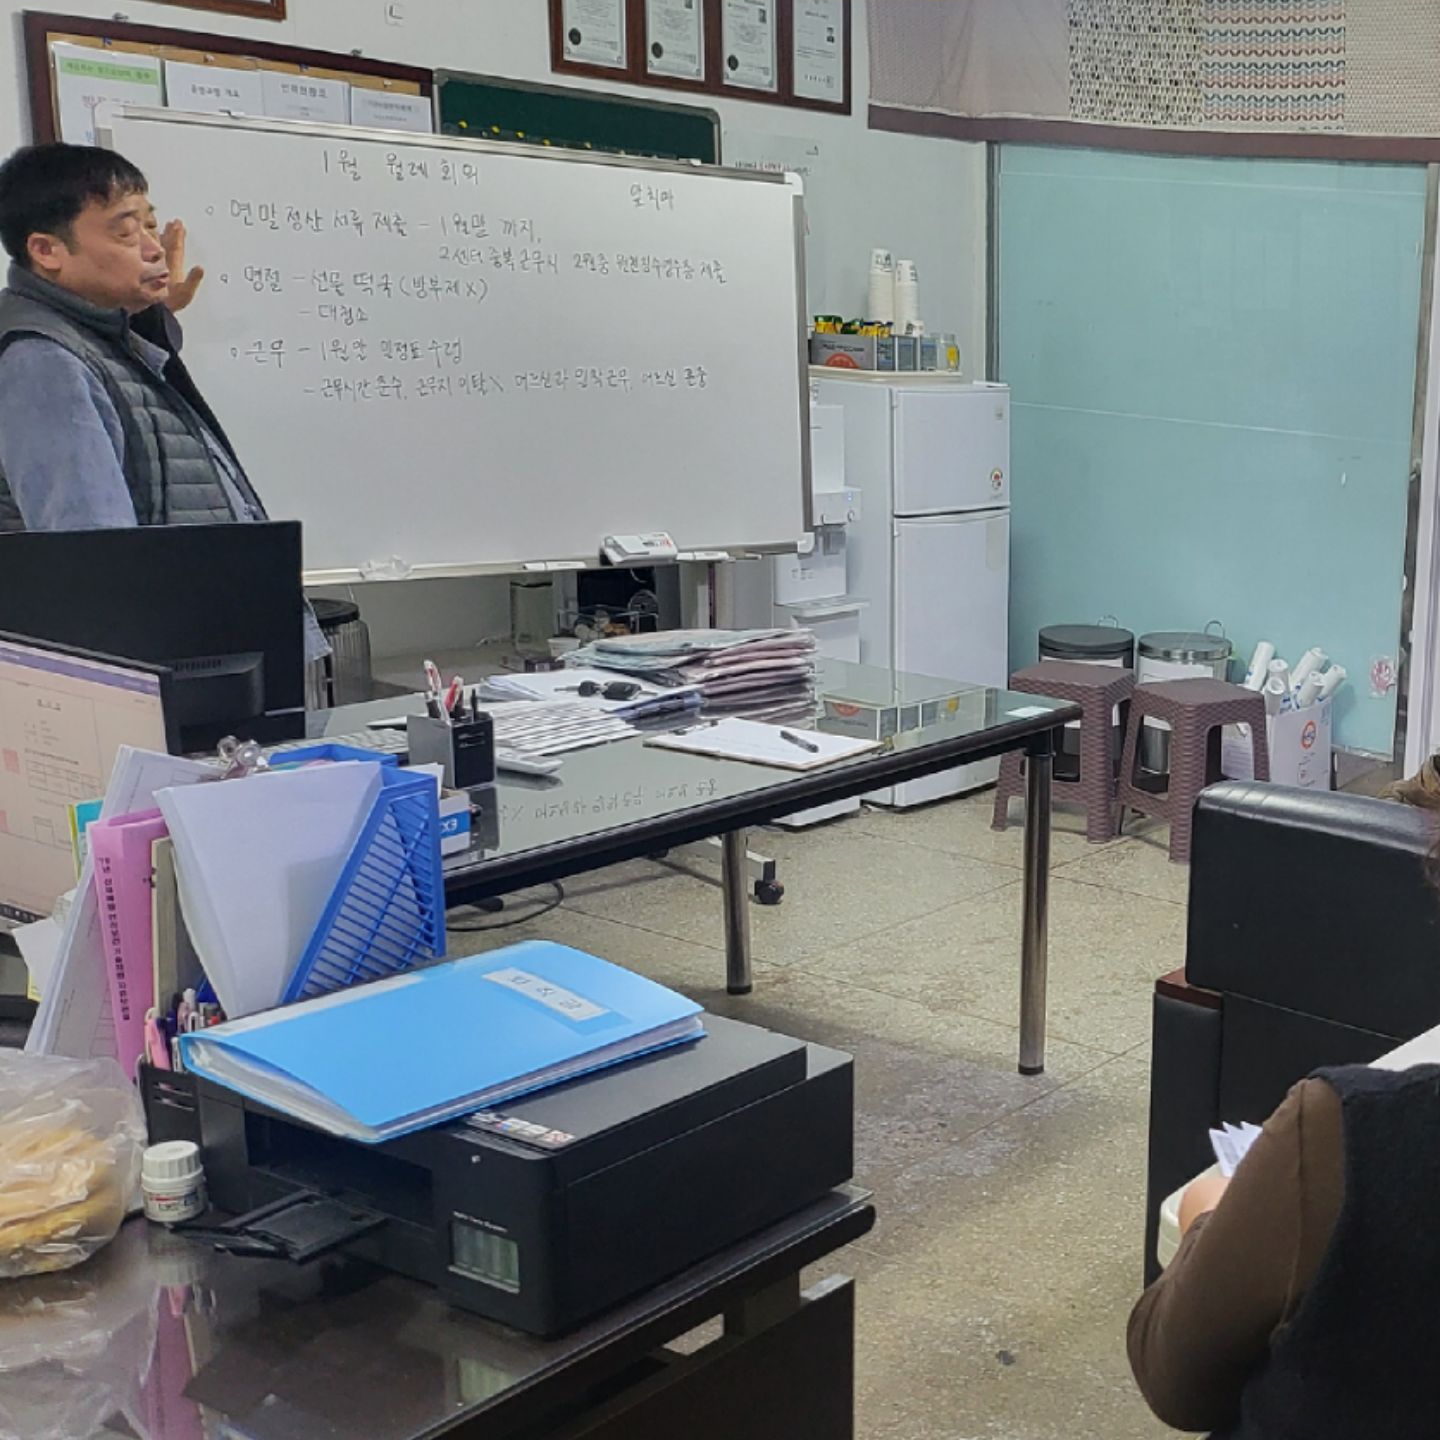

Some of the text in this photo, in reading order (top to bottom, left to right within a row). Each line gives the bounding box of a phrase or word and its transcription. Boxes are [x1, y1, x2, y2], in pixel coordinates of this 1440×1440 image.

[230, 199, 323, 232] 연말정산
[333, 210, 364, 237] 서류
[244, 266, 282, 293] 명절
[245, 339, 287, 368] 근무
